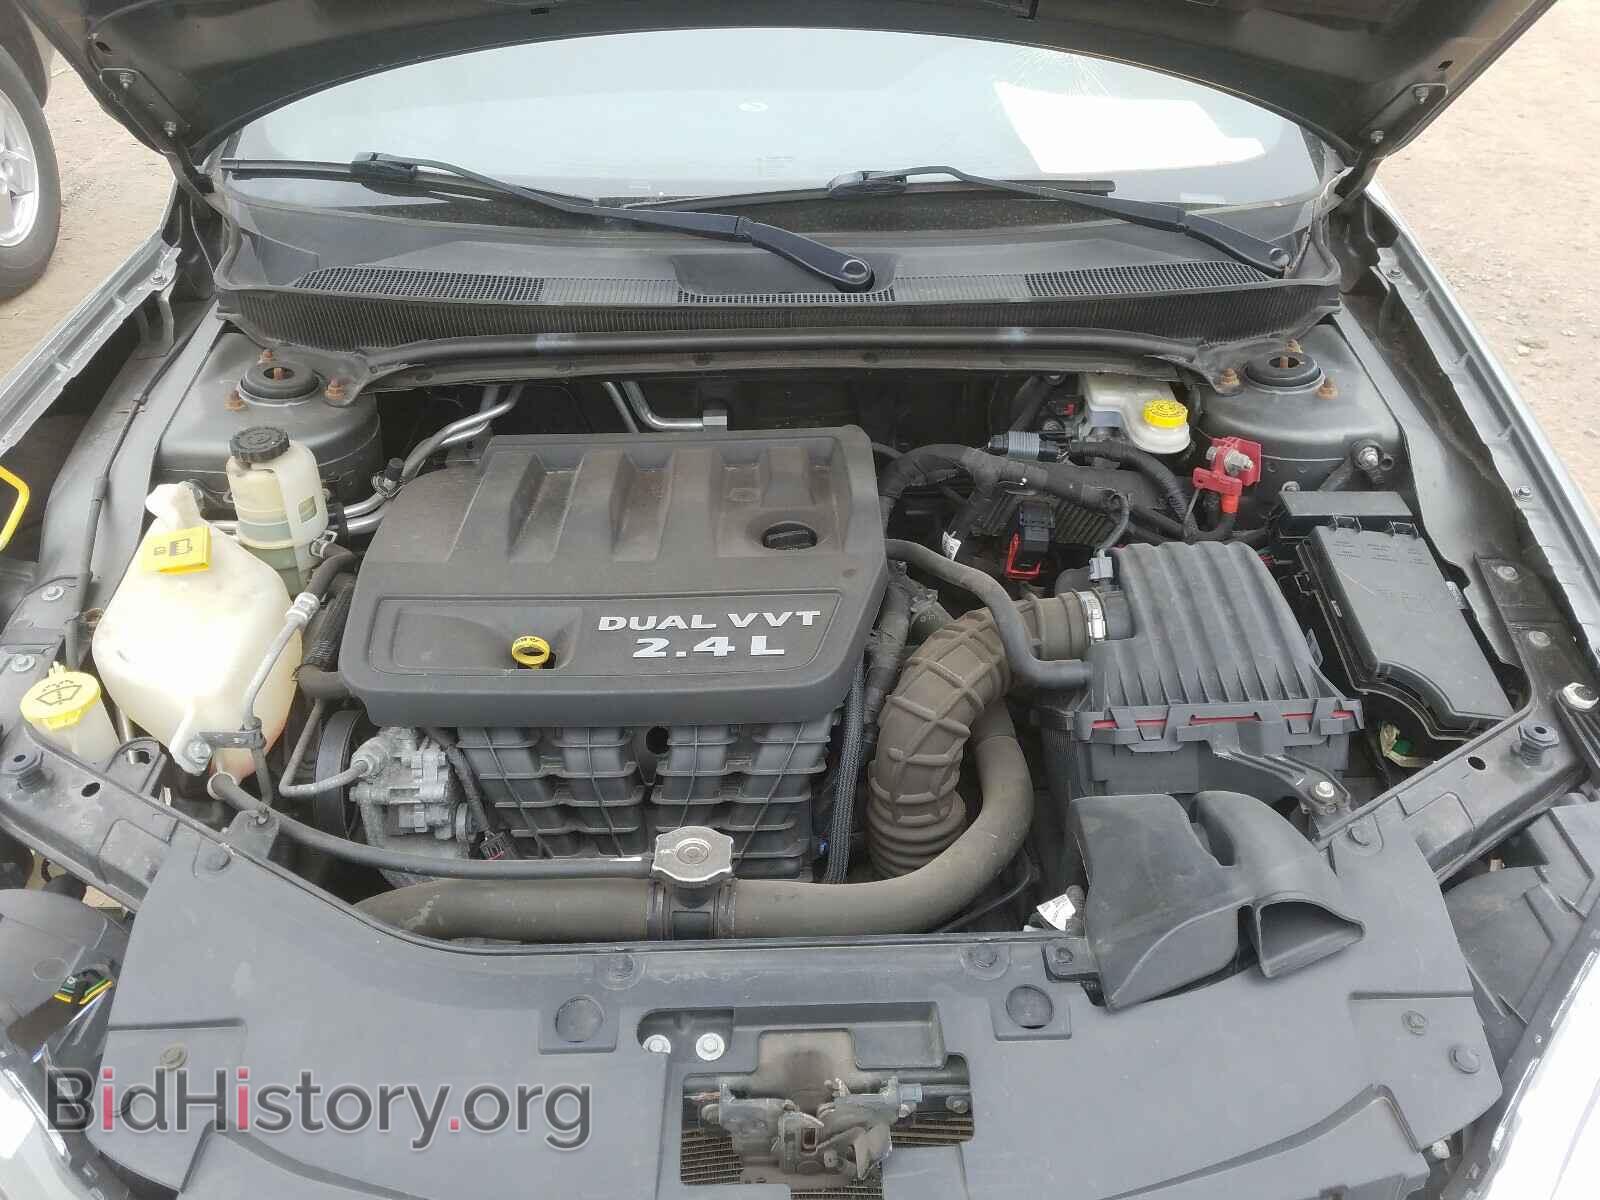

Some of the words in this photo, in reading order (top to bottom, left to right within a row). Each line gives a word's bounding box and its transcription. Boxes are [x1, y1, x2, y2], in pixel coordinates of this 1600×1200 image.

[598, 614, 717, 631] DUAL
[727, 610, 821, 628] VVT
[632, 636, 736, 658] 2.4
[750, 635, 785, 656] L
